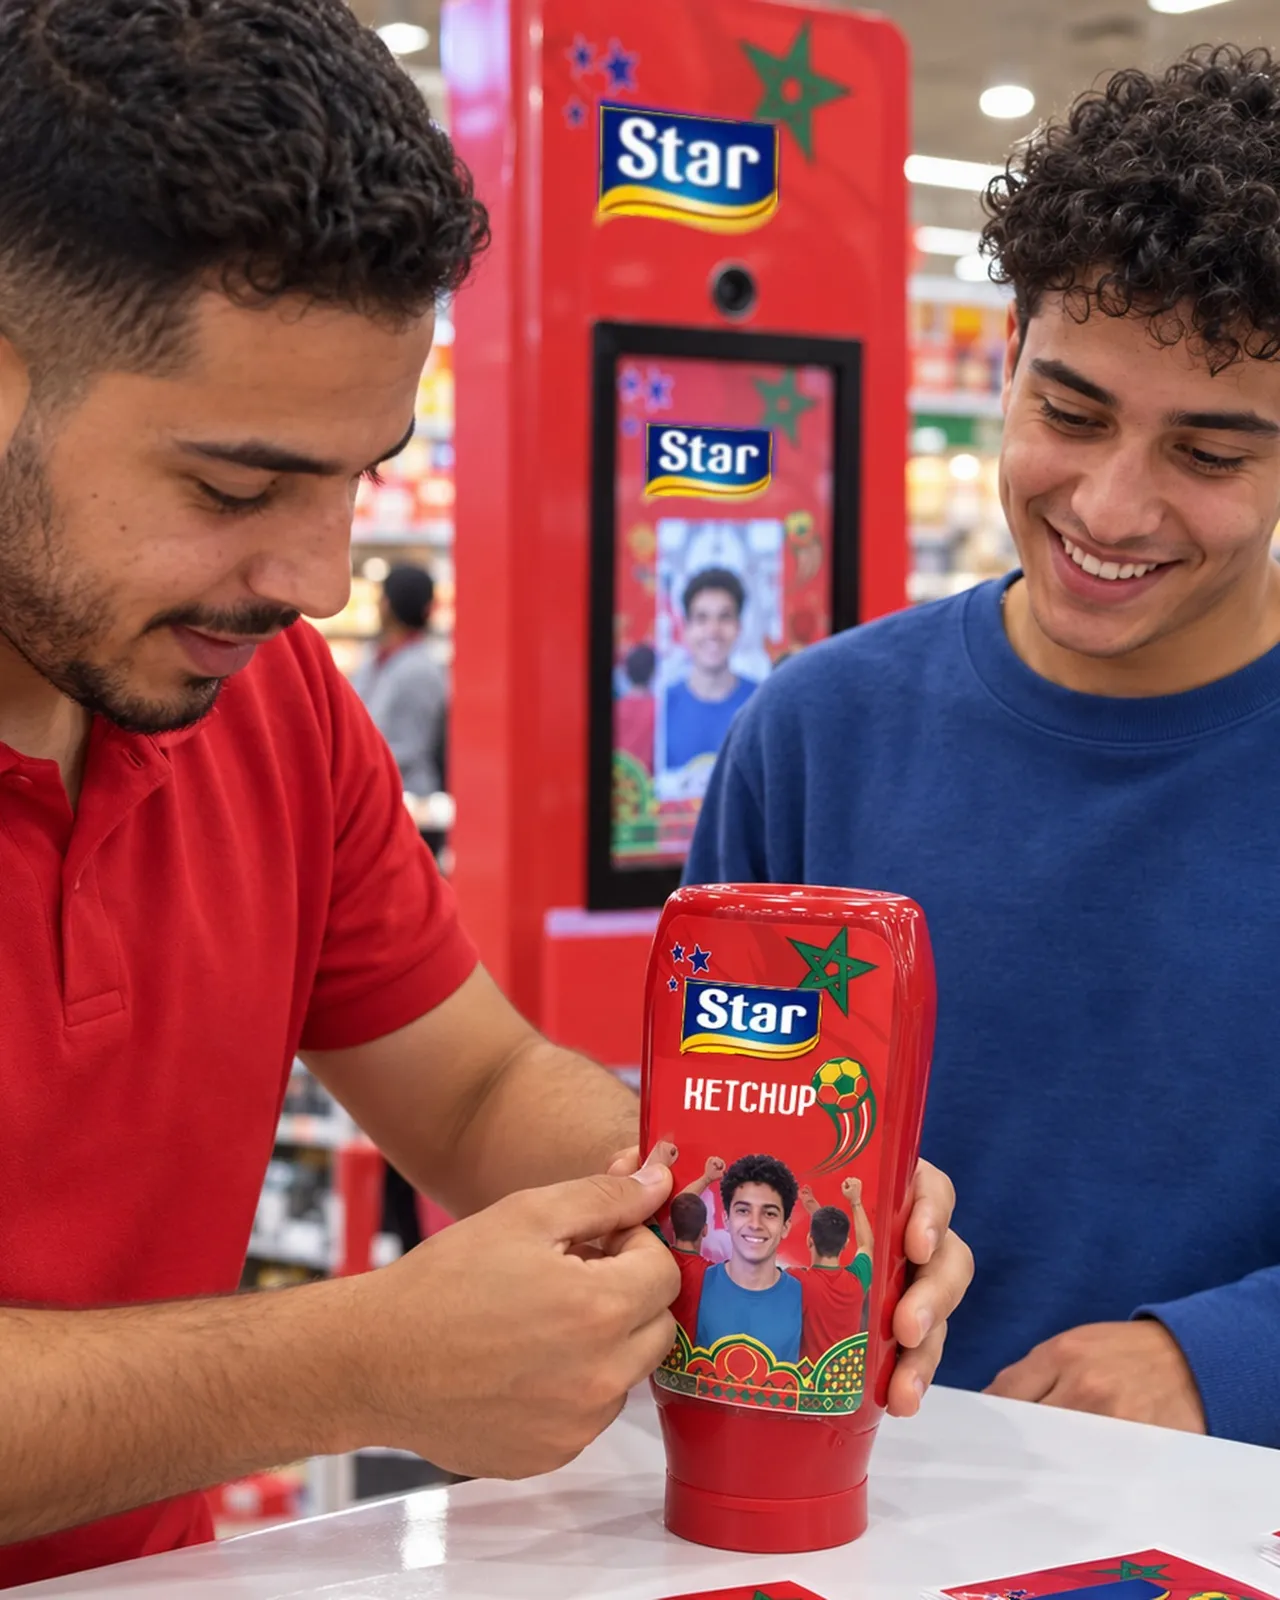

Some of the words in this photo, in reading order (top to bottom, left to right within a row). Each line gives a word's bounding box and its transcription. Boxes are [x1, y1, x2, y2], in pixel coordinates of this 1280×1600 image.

[617, 117, 760, 190] Star
[659, 430, 759, 475] Star
[696, 988, 807, 1034] Star
[684, 1077, 817, 1116] KETCHUP
